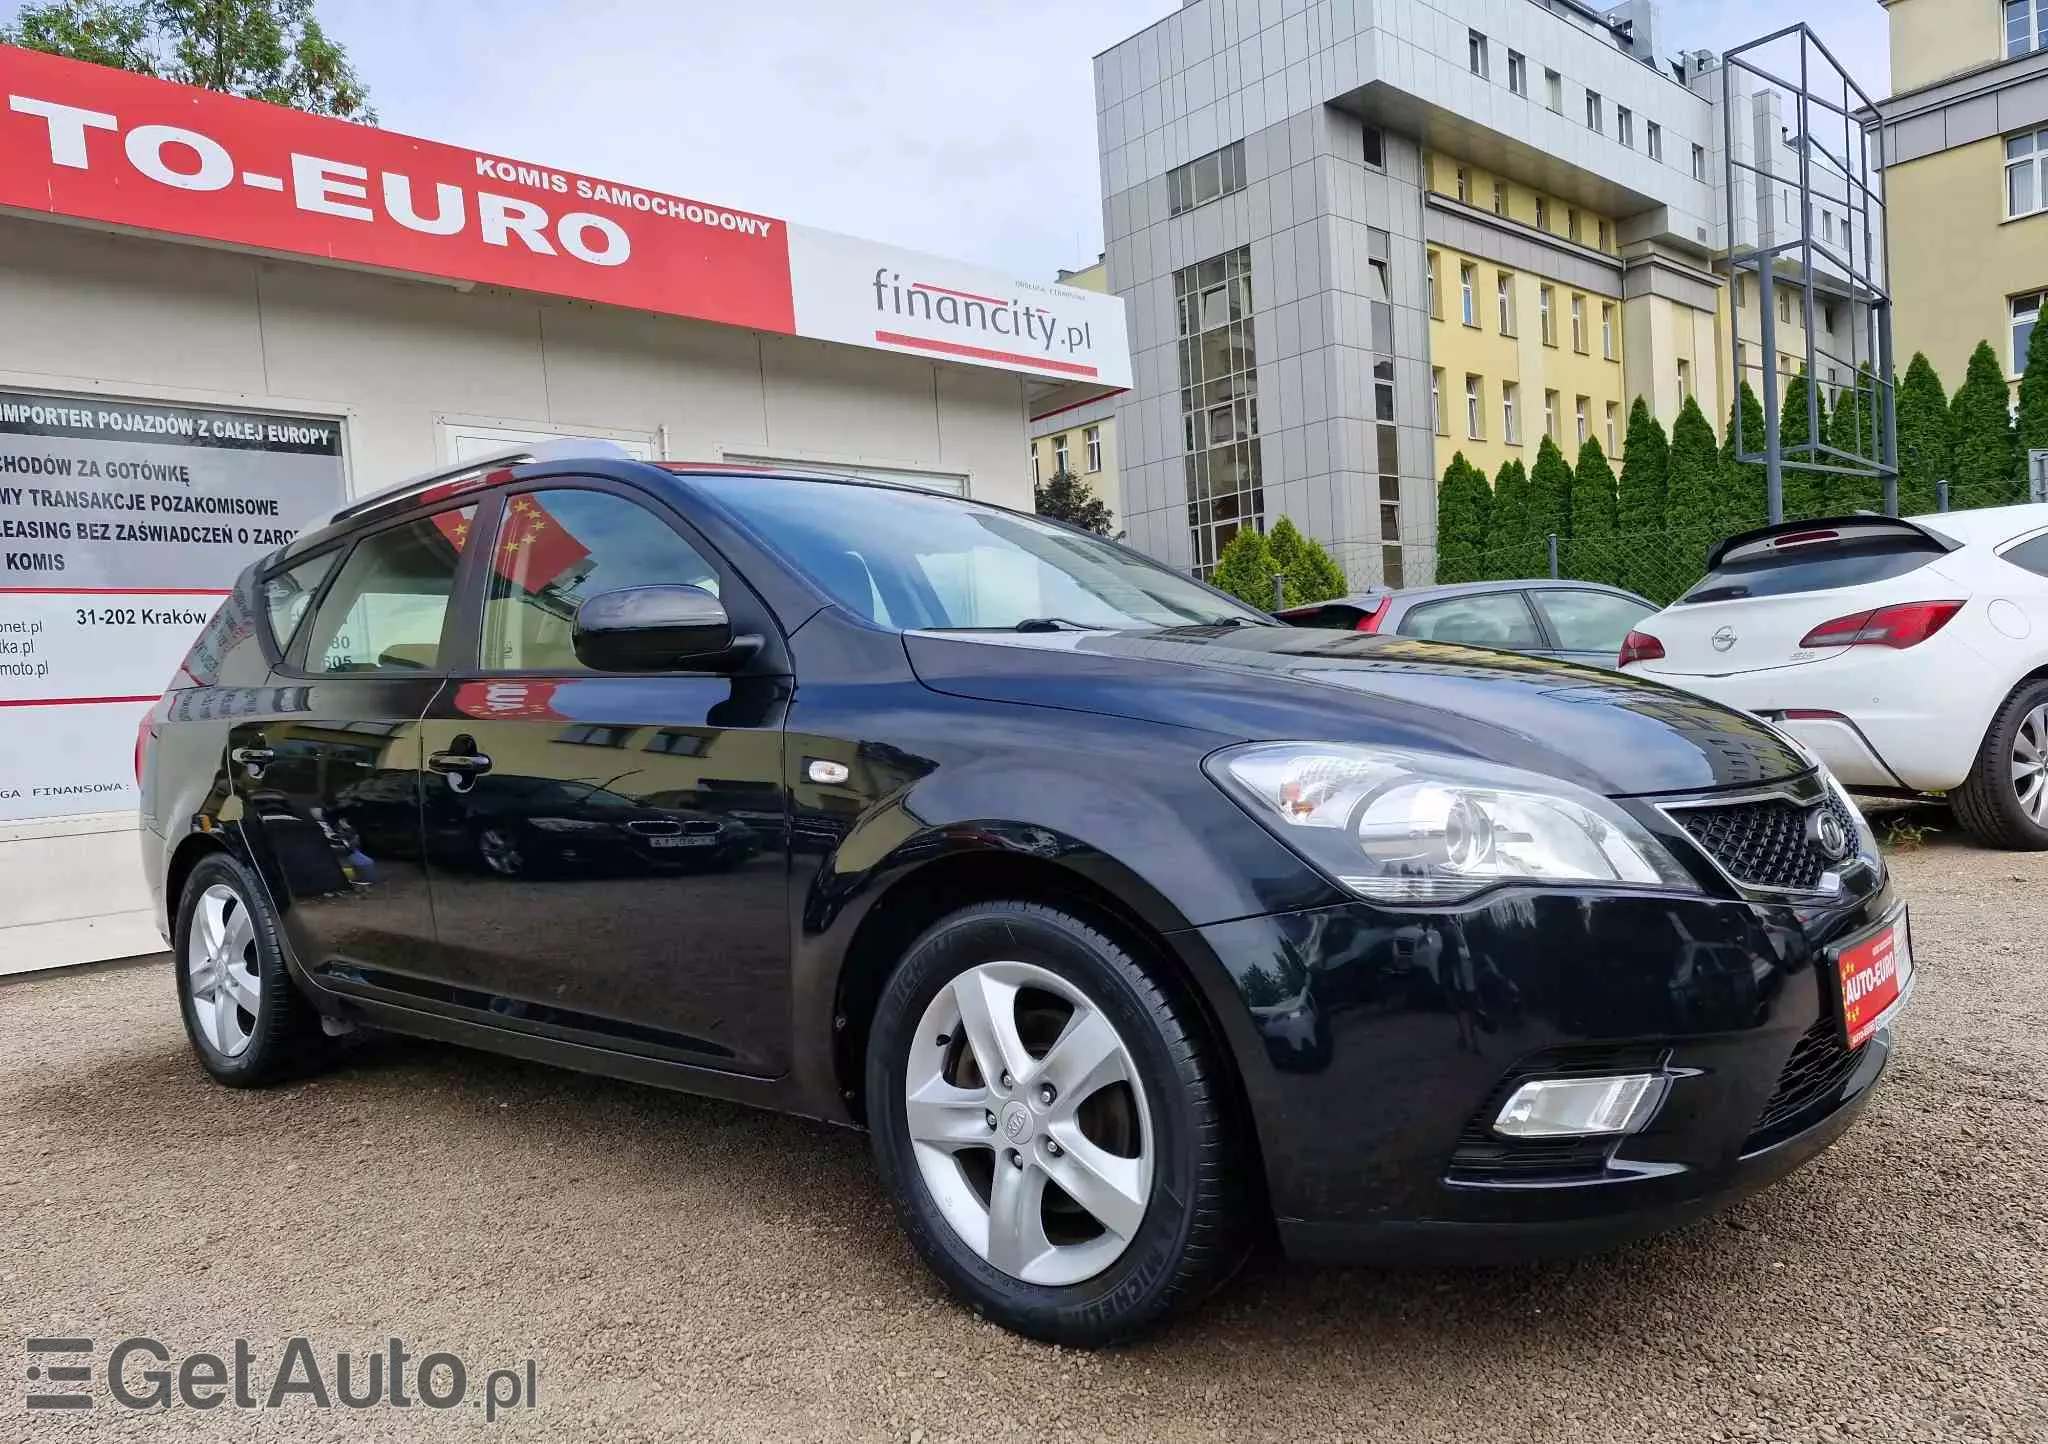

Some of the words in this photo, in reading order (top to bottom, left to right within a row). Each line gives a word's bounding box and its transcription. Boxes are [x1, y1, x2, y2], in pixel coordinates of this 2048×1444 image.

[10, 94, 631, 266] TO-EURO
[475, 156, 568, 193] KOMIS
[576, 179, 771, 237] SAMOCHODOWY
[873, 268, 1091, 353] financity.pl
[0, 403, 94, 428] IMPORTER
[99, 411, 193, 435] POJAZDÓW
[197, 419, 209, 436] Z
[213, 420, 263, 441] CAŁEJ
[267, 424, 329, 446] EUROPY
[0, 453, 71, 476] HODÓW
[77, 459, 100, 477] ZA
[105, 459, 189, 487] GOTÓWKĘ
[28, 488, 146, 511] TRANSAKCJE
[150, 494, 279, 516] POZAKOMISOWE
[0, 520, 71, 539] EASING
[77, 522, 111, 540] BEZ
[115, 521, 233, 543] ZAŚWIADCZEŃ
[238, 527, 249, 544] O
[253, 528, 299, 545] ZARO
[6, 552, 65, 571] KOMIS
[76, 608, 135, 625] 31-202
[142, 608, 207, 625] Kraków
[0, 659, 49, 679] moto.pl
[0, 789, 21, 799] GA
[32, 783, 129, 797] FINANSOWA:
[1846, 951, 1895, 1006] AUTO-EURO
